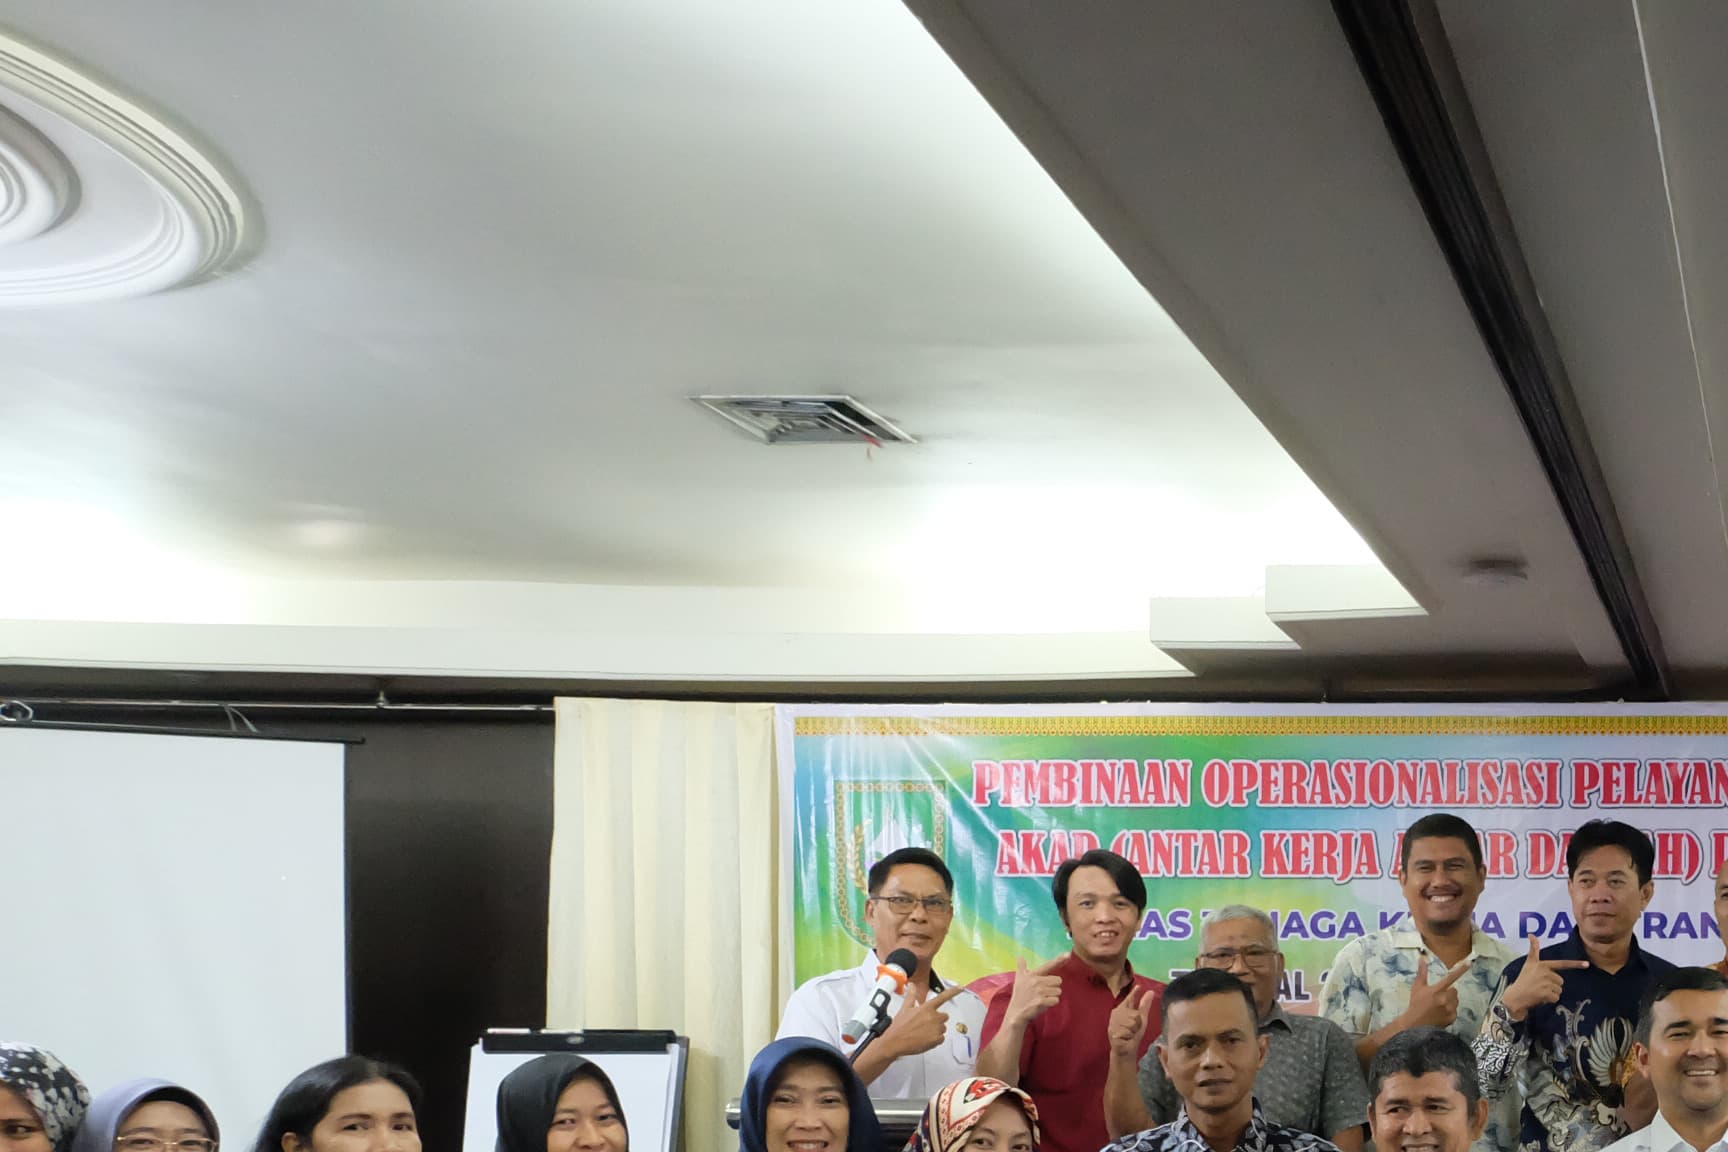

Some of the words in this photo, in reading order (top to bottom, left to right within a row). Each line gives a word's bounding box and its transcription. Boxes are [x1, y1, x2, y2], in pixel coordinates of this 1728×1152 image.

[972, 760, 1191, 806] PEMBINAAN
[1203, 760, 1562, 806] OPERASIONALISASI
[1260, 831, 1380, 882] KERJA
